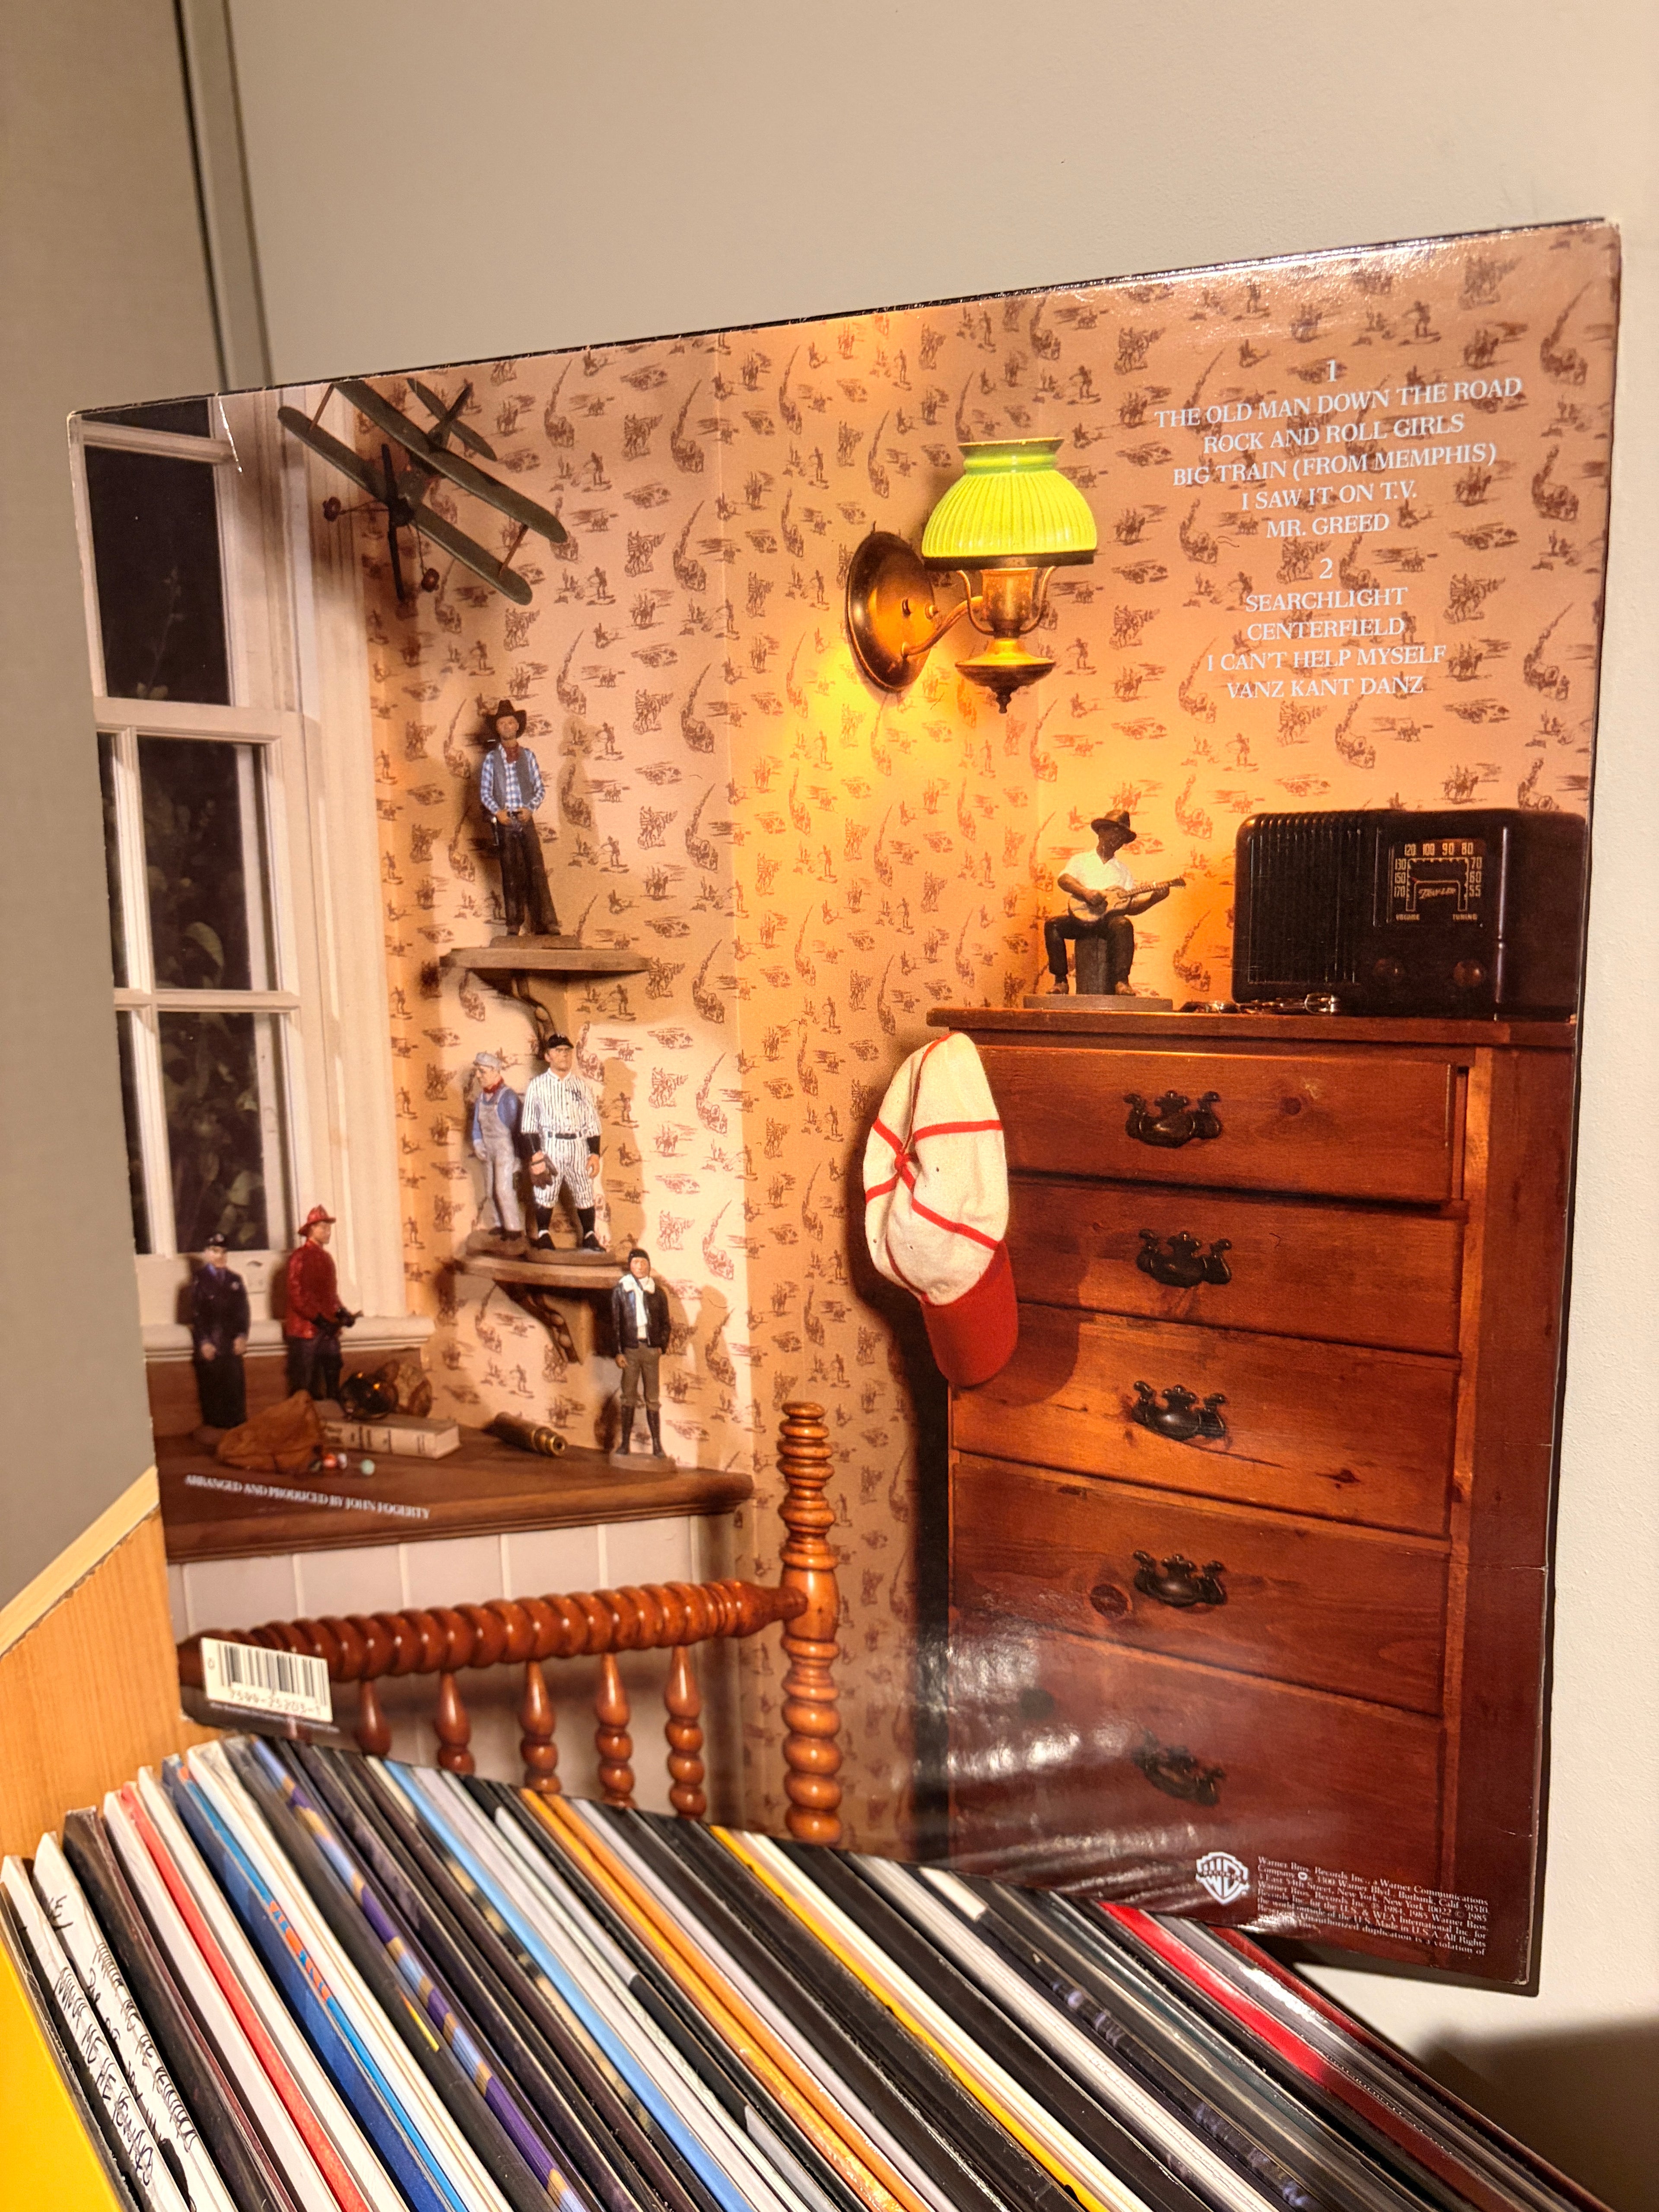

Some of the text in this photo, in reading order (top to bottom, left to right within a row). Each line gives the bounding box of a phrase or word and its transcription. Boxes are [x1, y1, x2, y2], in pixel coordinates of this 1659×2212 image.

[1328, 360, 1336, 381] 1
[1154, 378, 1522, 427] THE OLD MAN DOWN THE ROAD
[1204, 413, 1464, 453] ROCK AND ROLL GIRLS
[1173, 443, 1496, 485] BIG TRAIN (FROM MEMPHIS)
[1242, 480, 1417, 510] I SAW IT ON T.V.
[1267, 513, 1389, 538] MR. GREED
[1319, 558, 1333, 578] 2
[1246, 587, 1408, 612] SEARCHLIGHT
[1247, 618, 1405, 641] CENTERFIELD
[1208, 645, 1446, 671] I CAN'T HELP MYSELF
[1227, 676, 1423, 698] VANZ KANT DANZ
[1405, 842, 1474, 856] 120 100 90 80
[1395, 858, 1406, 870] 130
[1471, 857, 1482, 869] 70
[1395, 872, 1406, 884] 150
[1470, 871, 1482, 884] 60
[1394, 886, 1406, 898] 170
[1469, 885, 1481, 898] 55
